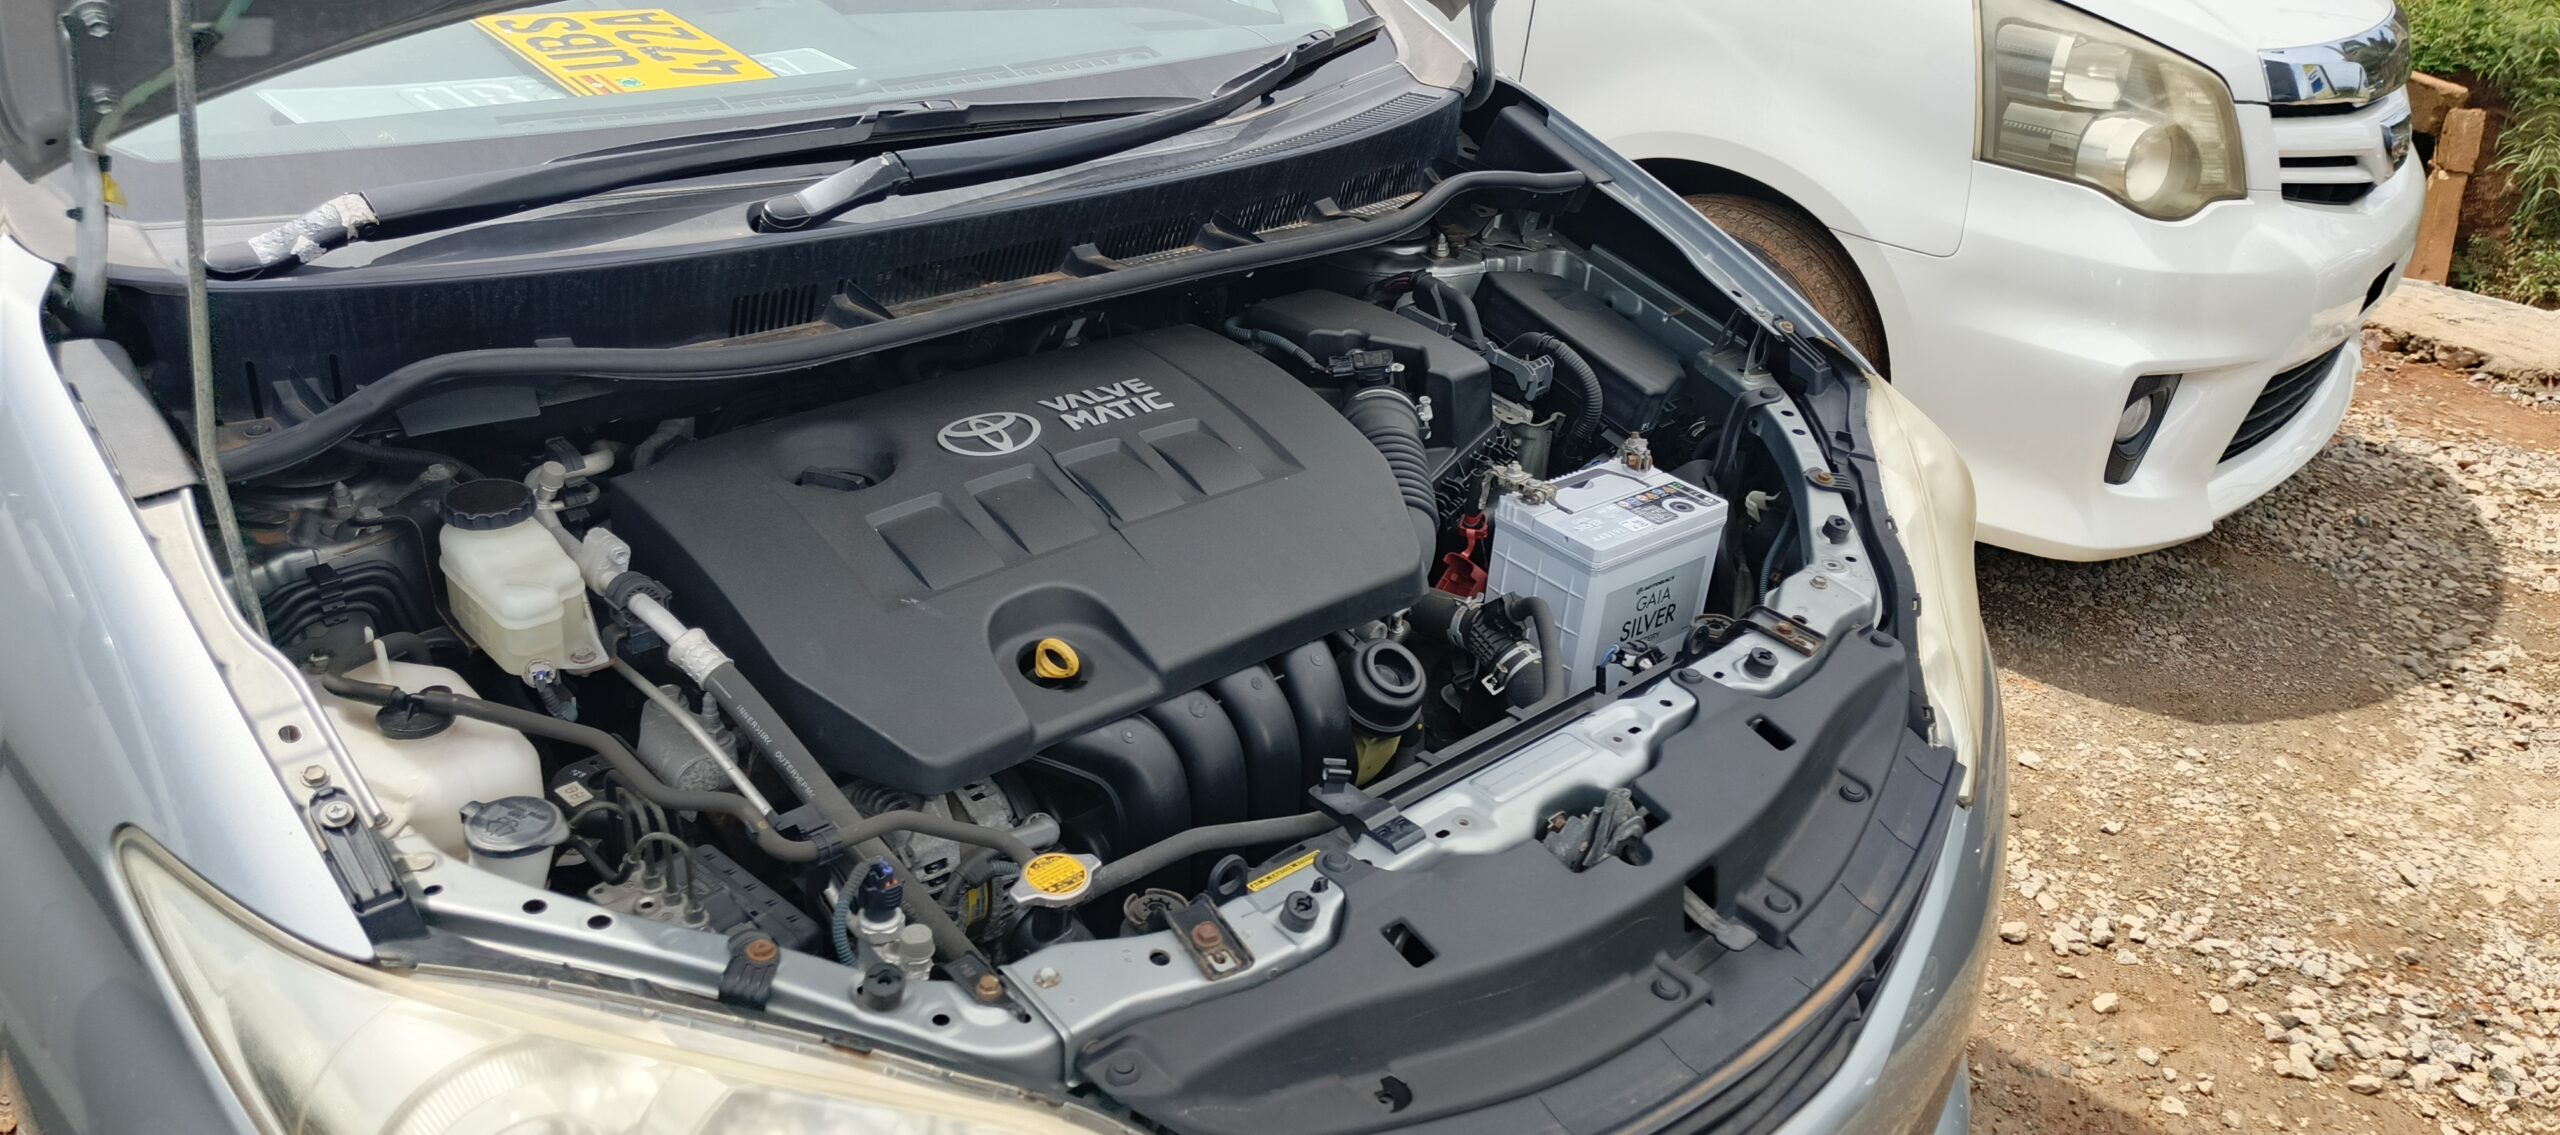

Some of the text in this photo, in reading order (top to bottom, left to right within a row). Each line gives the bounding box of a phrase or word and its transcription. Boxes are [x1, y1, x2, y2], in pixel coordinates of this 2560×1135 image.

[495, 16, 641, 73] UBS
[589, 12, 747, 77] 472A
[1037, 378, 1154, 411] VALVE
[1060, 391, 1175, 431] MATIC
[1636, 587, 1671, 611] GAIA
[1620, 603, 1676, 641] SILVER
